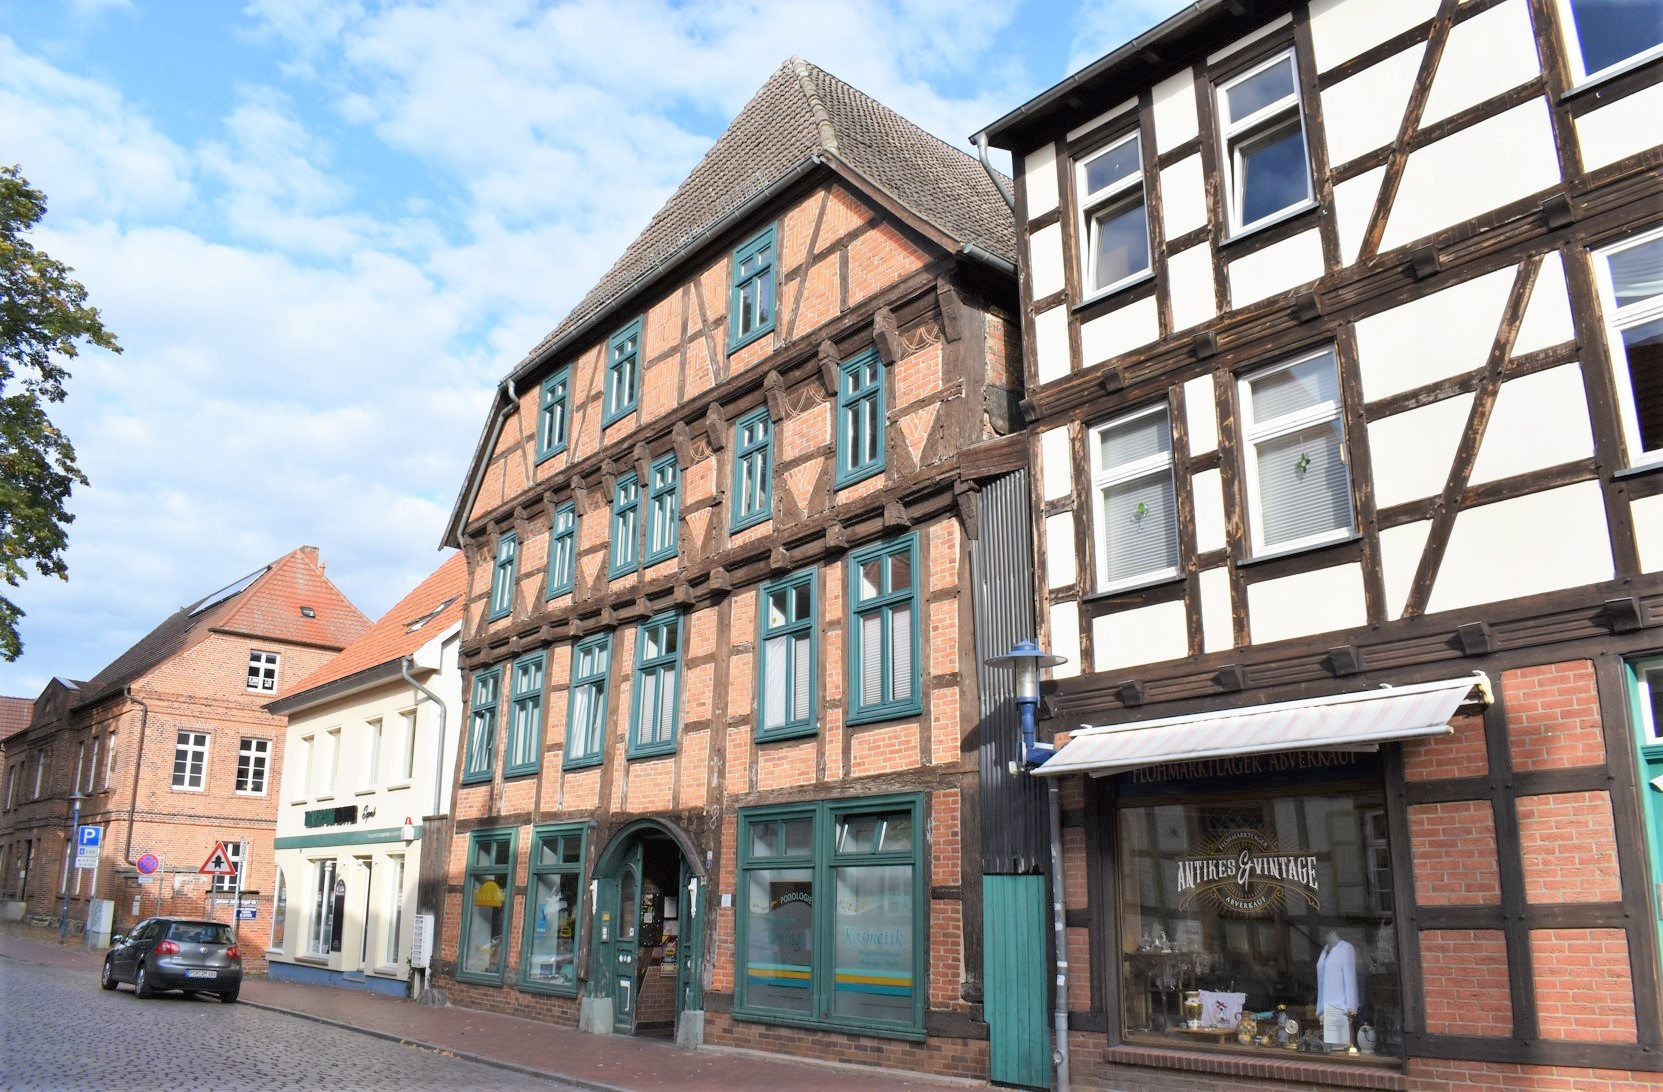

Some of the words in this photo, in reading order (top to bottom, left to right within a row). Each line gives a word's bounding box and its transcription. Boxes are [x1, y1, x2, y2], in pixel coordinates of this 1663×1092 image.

[83, 828, 96, 844] P
[1177, 859, 1236, 892] ANTIKES
[1237, 849, 1254, 892] &
[1253, 856, 1319, 890] VINTAGE
[780, 892, 813, 905] PODOLOGIE
[1225, 896, 1267, 910] ABVERKAUF
[842, 926, 904, 949] Kosmetik
